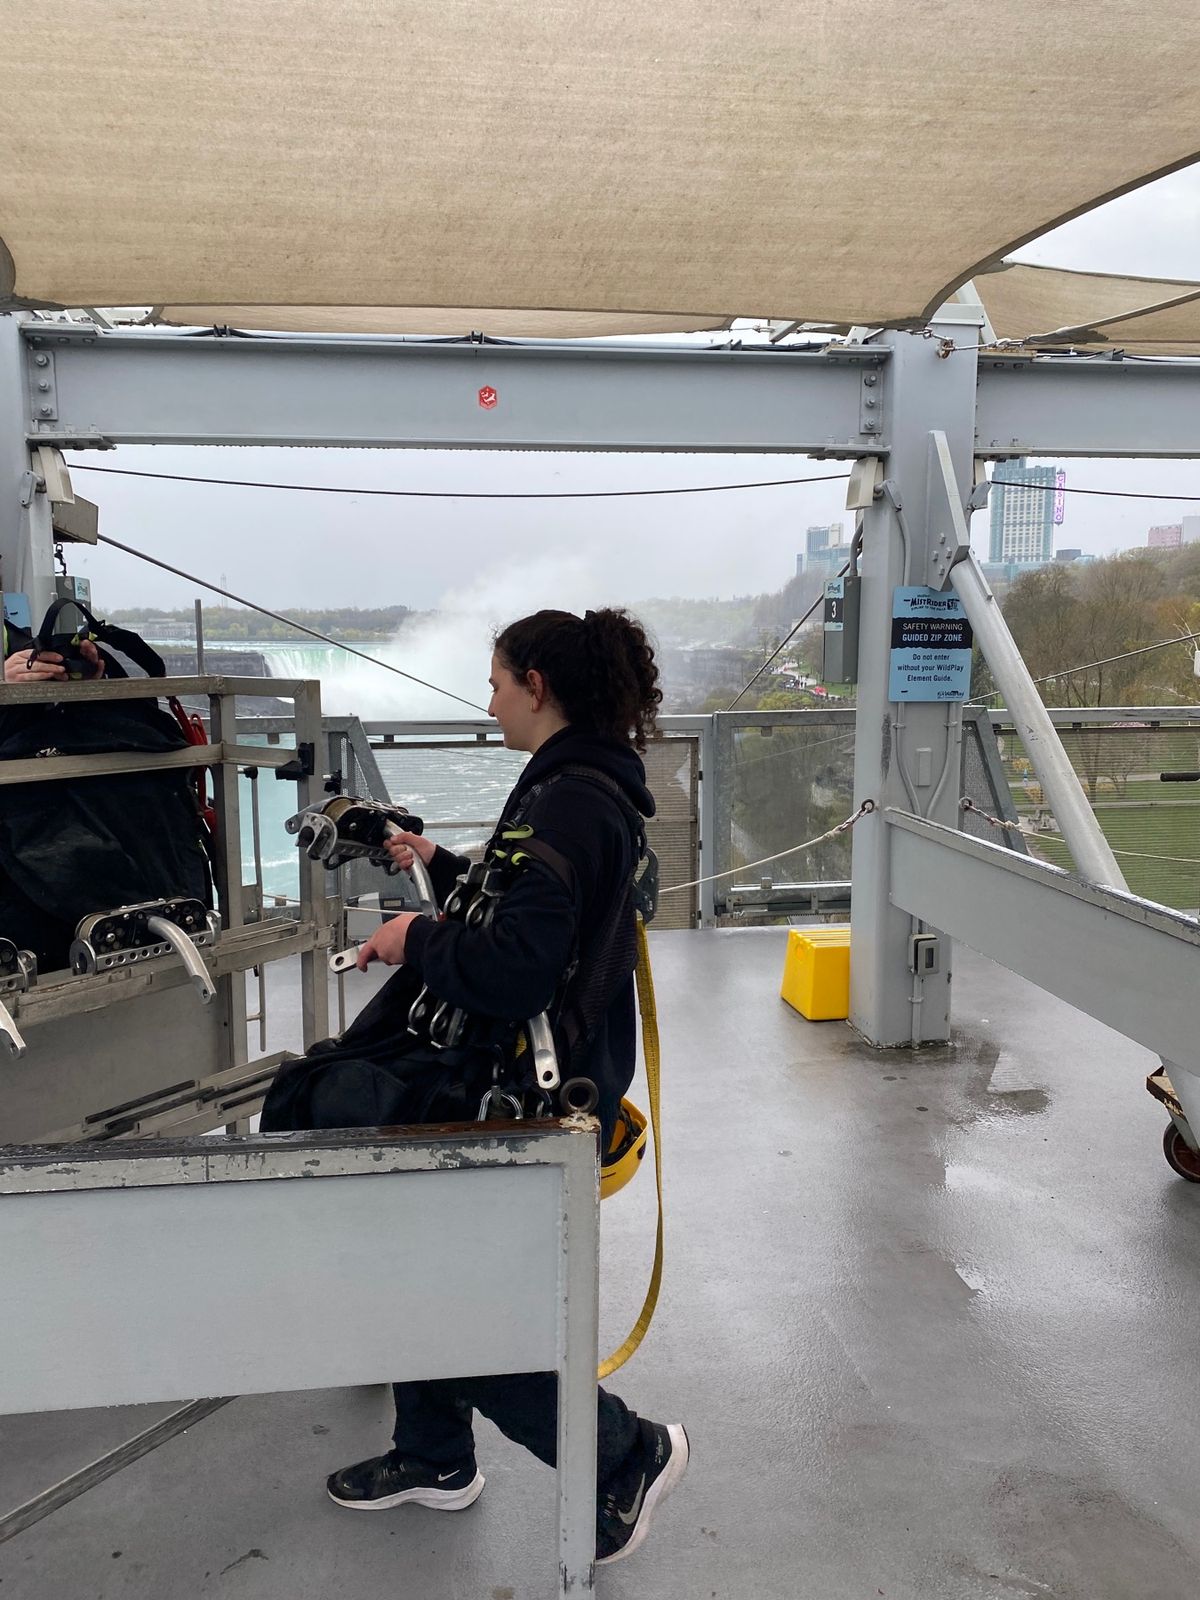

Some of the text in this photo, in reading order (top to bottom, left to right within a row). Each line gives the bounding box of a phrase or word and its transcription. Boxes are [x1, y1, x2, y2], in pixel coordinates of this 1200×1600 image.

[1056, 475, 1064, 521] CASINO
[831, 600, 837, 619] 3
[902, 622, 963, 631] SAFETY WARNING
[902, 633, 963, 642] GUIDED ZIP ZONE
[936, 664, 964, 672] WildPlay
[907, 674, 953, 682] Element Guide.
